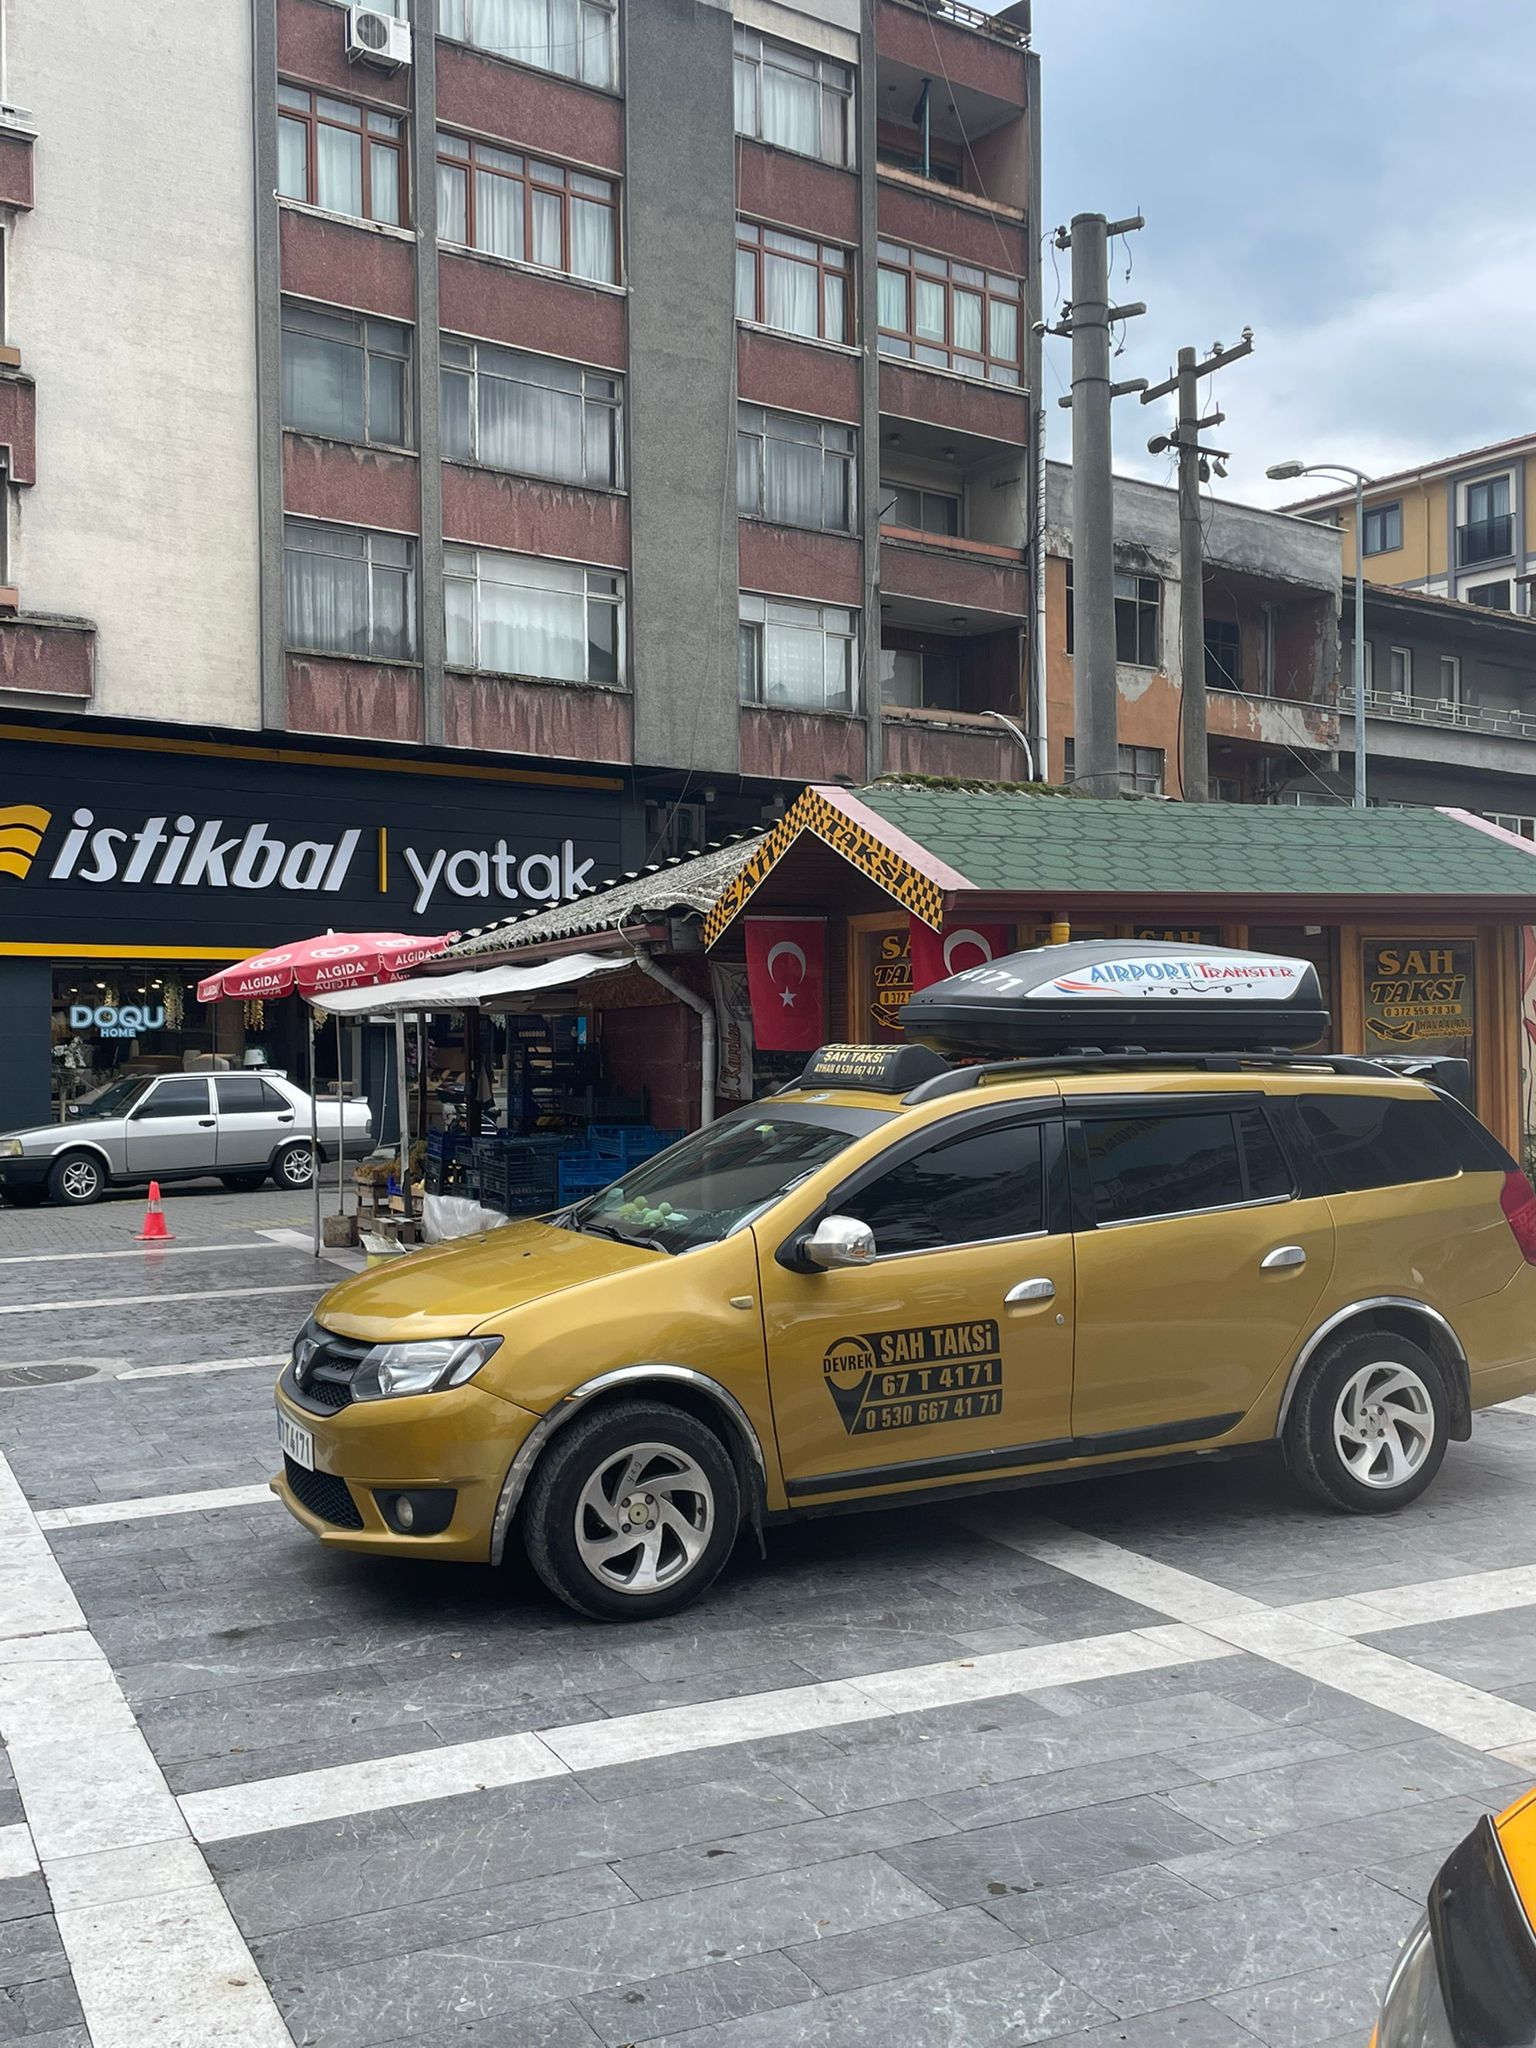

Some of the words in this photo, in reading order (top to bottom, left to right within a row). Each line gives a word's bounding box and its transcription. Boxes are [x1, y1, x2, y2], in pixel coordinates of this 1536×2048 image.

[48, 807, 362, 892] istikbal
[403, 839, 595, 915] yatak
[315, 961, 366, 981] ALGIDA
[1090, 961, 1190, 983] AIRPORT
[239, 975, 281, 992] ALGIDA
[70, 1005, 165, 1032] DOQU
[1393, 1007, 1410, 1016] 372
[100, 1028, 136, 1038] HOME
[853, 1065, 866, 1076] 667
[866, 1065, 875, 1076] 41
[876, 1066, 885, 1076] 71
[823, 1353, 873, 1374] DEVREK
[881, 1373, 910, 1397] 67
[918, 1370, 932, 1391] T
[938, 1362, 993, 1388] 4171
[865, 1410, 876, 1430] 0
[881, 1405, 912, 1429] 530
[918, 1399, 949, 1423] 667
[953, 1396, 972, 1417] 41
[980, 1392, 998, 1414] 71
